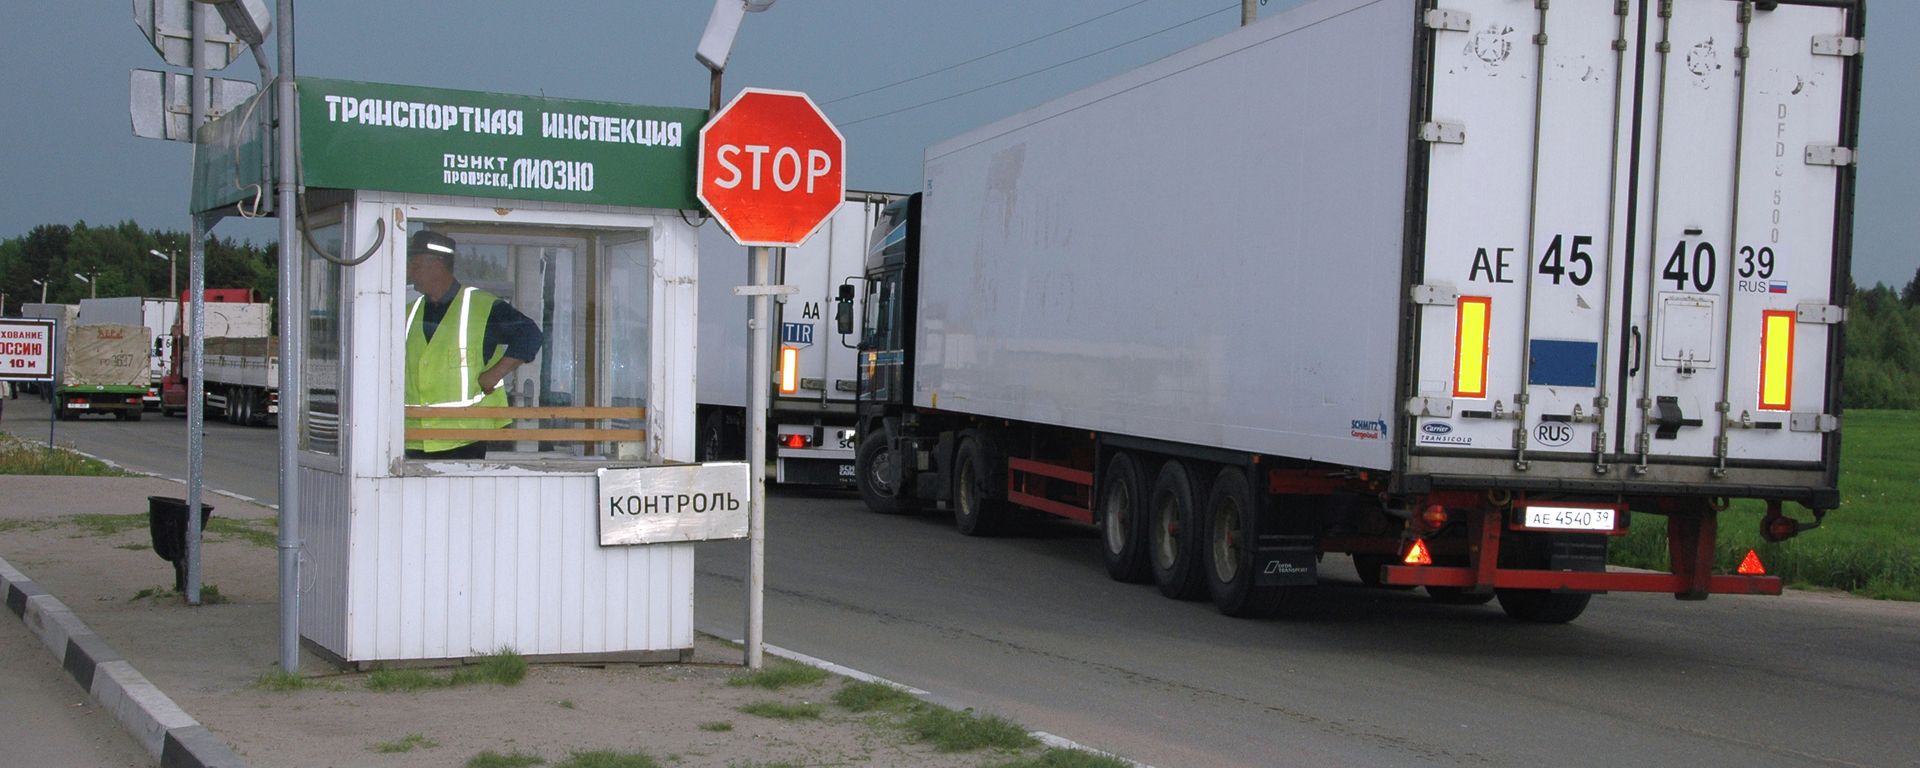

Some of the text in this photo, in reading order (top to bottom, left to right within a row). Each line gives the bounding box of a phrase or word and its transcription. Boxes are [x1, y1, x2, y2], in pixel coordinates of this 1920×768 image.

[325, 95, 682, 148] ТРАНСПОРТНАЯ ИНСПЕКЦИЯ
[443, 153, 508, 171] ПУНКТ
[713, 143, 832, 194] STOP
[443, 170, 508, 187] ПРОПУСКА
[1468, 233, 1775, 293] AE 45 40 39
[1738, 280, 1767, 293] RUS
[802, 301, 820, 320] AA
[1, 331, 43, 340] ХОВАНИЕ
[785, 323, 811, 343] TIR
[9, 358, 25, 368] 10
[1351, 419, 1378, 431] SCHMITZ
[1424, 424, 1449, 434] Carrier
[1537, 423, 1571, 443] RUS
[1351, 429, 1378, 440] Cargobull
[1421, 435, 1473, 443] TRANSICOLD
[609, 491, 740, 517] КОНТРОЛЬ
[1533, 511, 1609, 526] AE 4540 39
